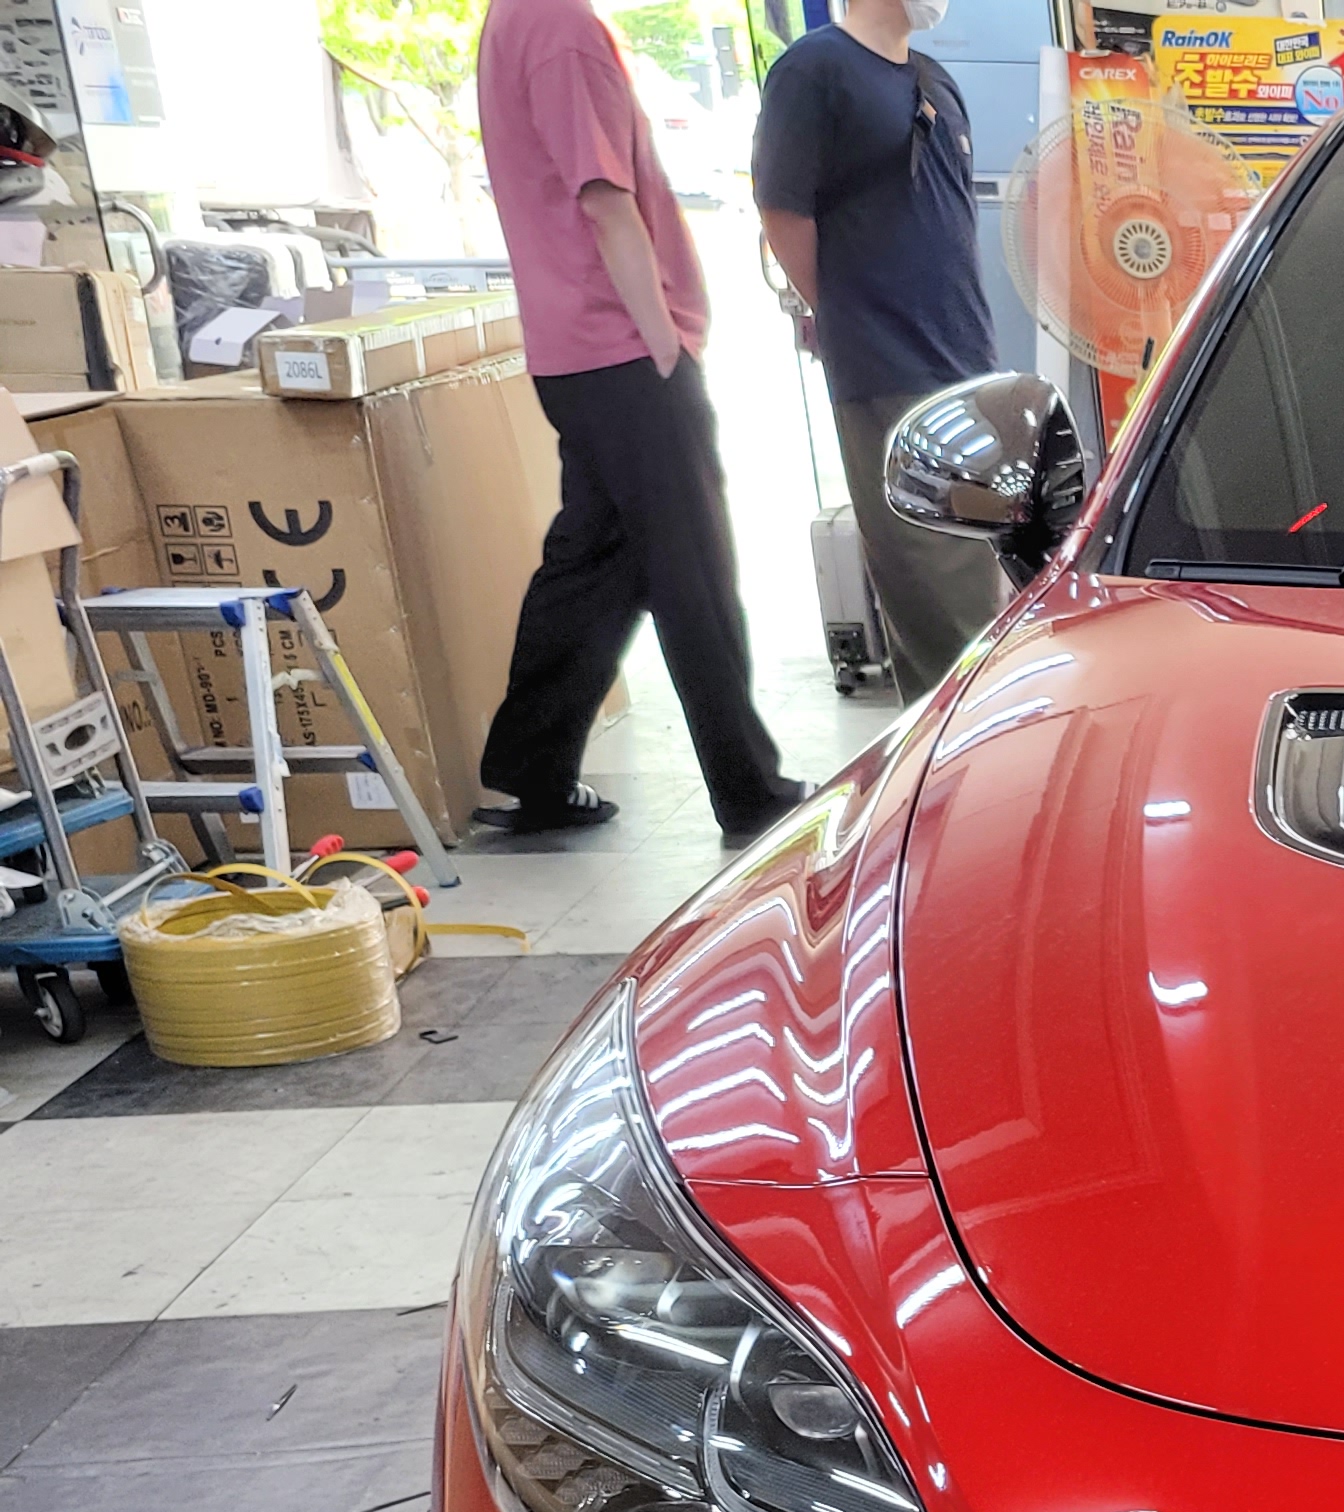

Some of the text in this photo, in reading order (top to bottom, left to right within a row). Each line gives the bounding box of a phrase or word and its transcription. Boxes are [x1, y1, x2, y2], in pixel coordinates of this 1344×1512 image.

[1162, 30, 1233, 48] RainOK
[1206, 54, 1270, 68] 하이브리드
[1079, 67, 1138, 82] CAREX
[1174, 53, 1293, 99] 초발수 와이퍼
[284, 361, 323, 379] 2086L
[210, 630, 226, 657] PCS
